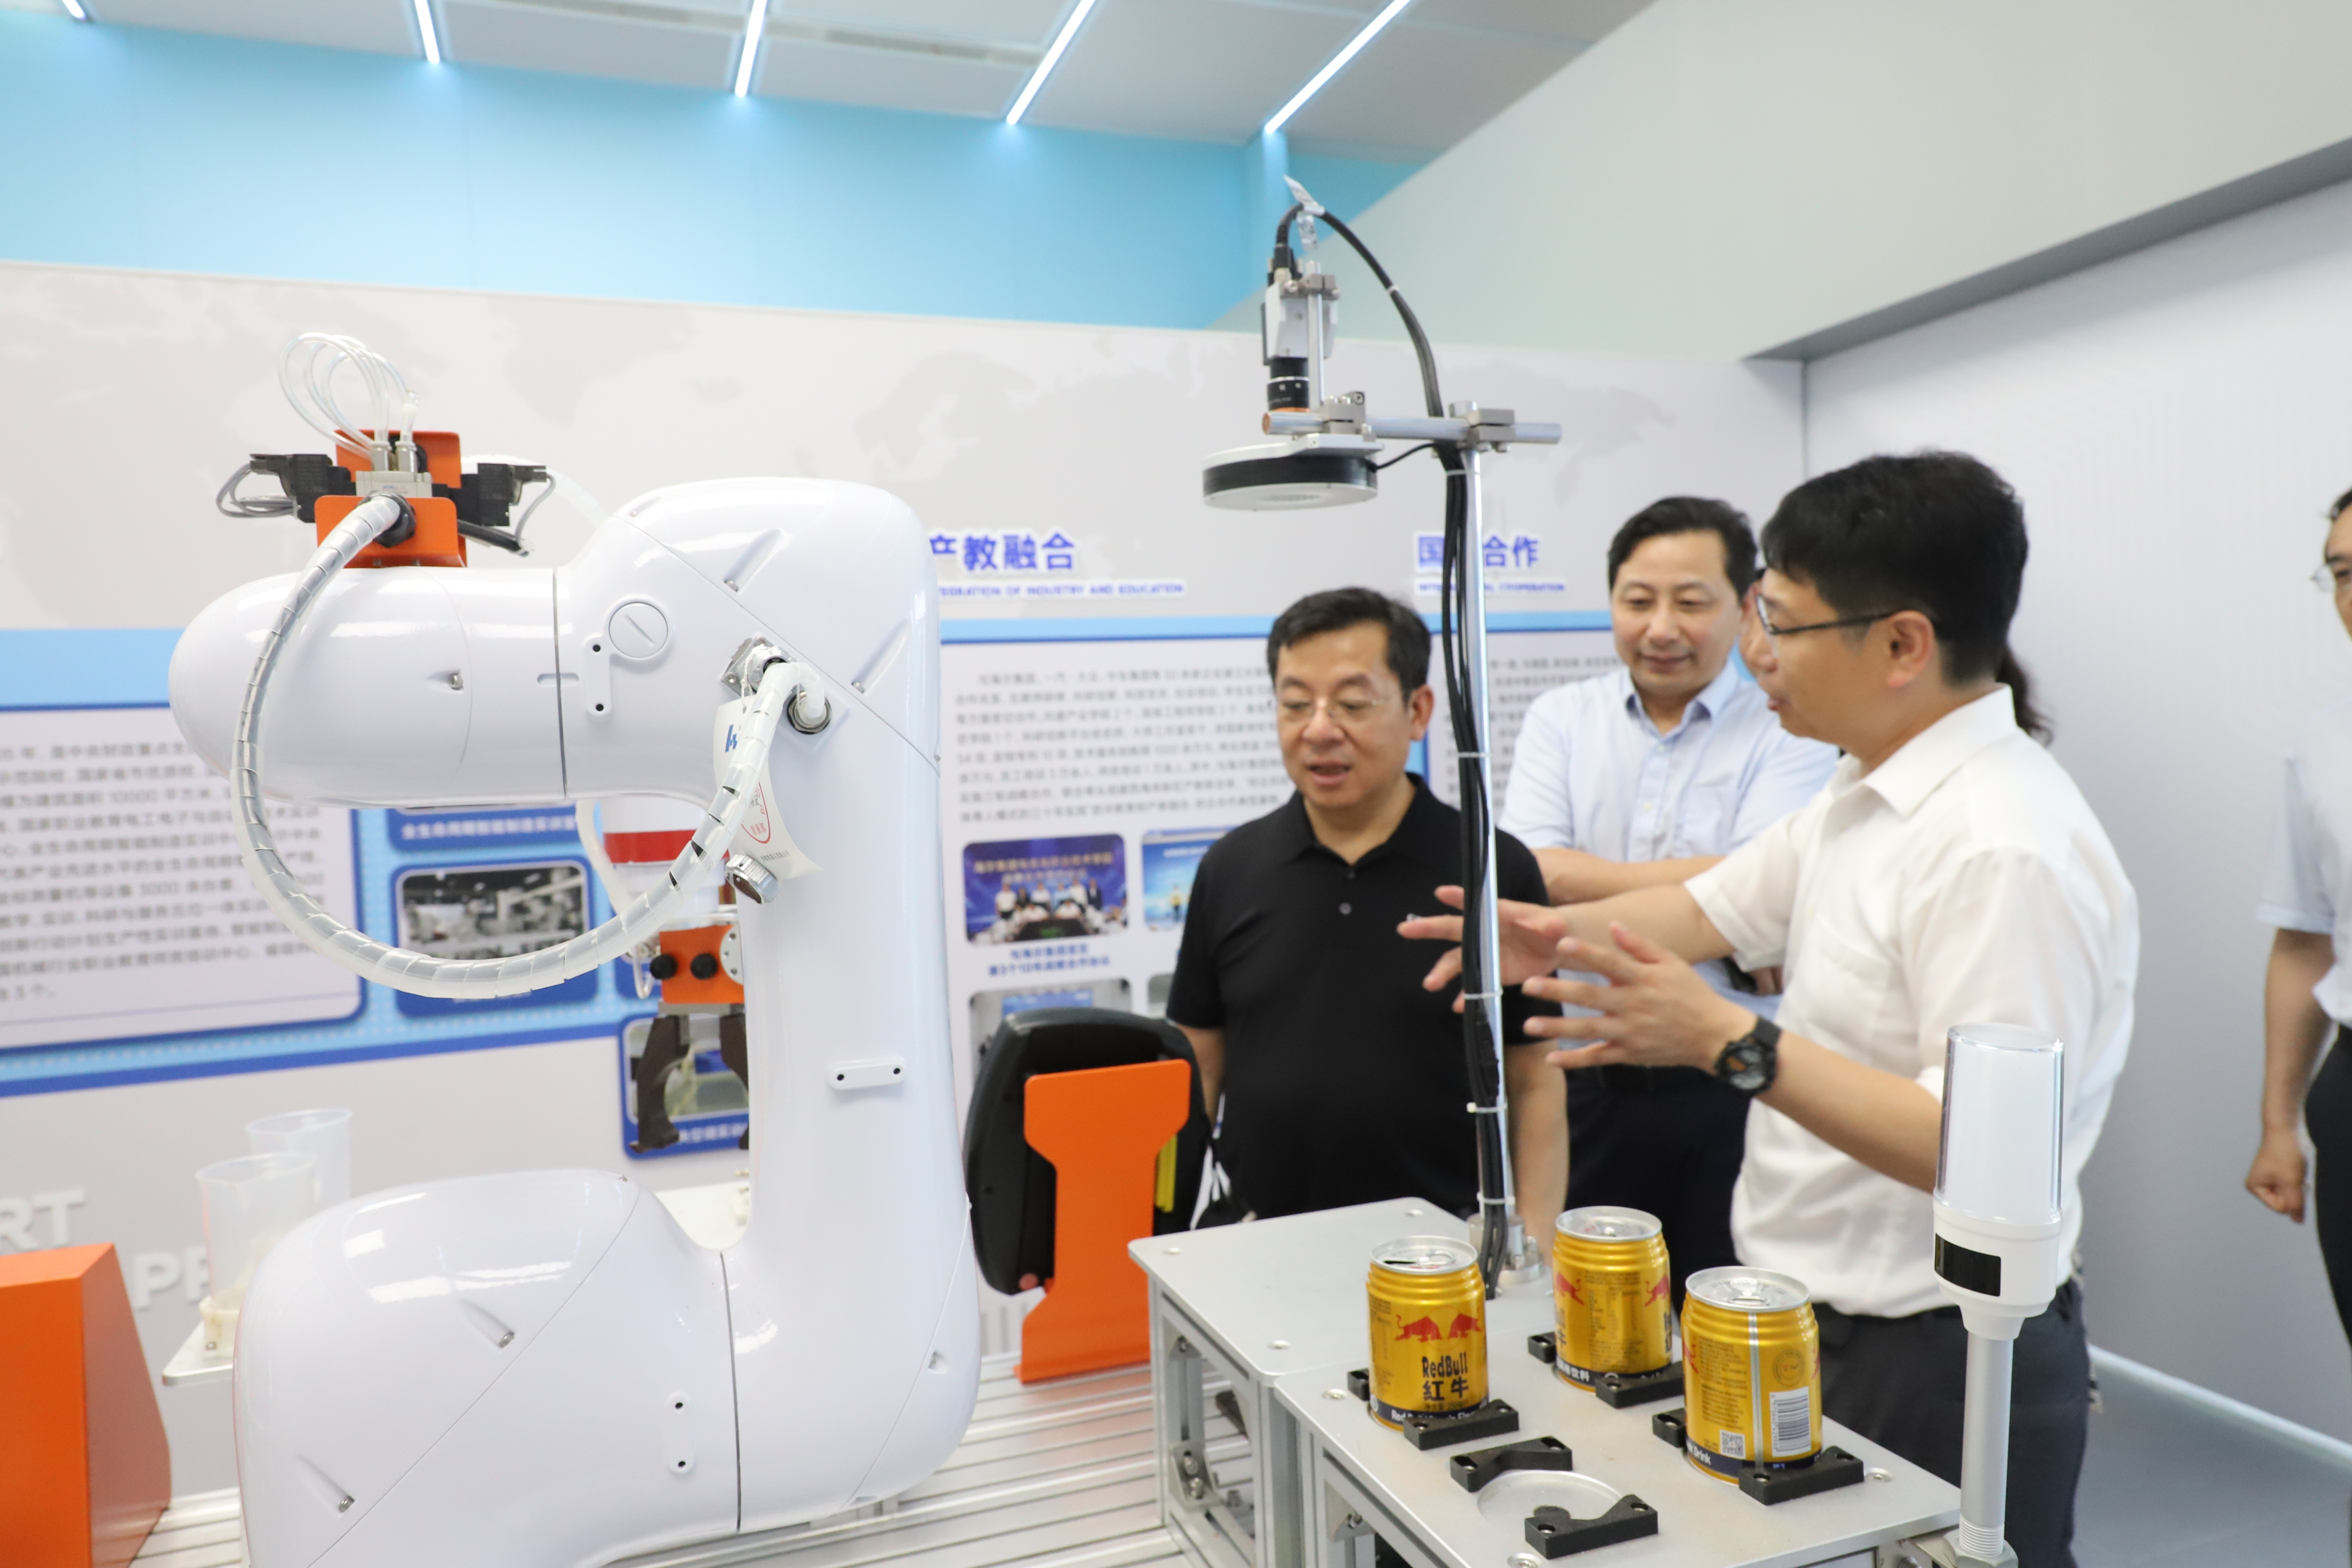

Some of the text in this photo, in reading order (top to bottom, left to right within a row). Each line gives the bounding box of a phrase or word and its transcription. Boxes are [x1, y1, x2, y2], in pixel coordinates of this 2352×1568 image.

[1419, 535, 1539, 567] 国合作
[1422, 1352, 1468, 1378] RedBull
[1423, 1377, 1469, 1401] 红牛
